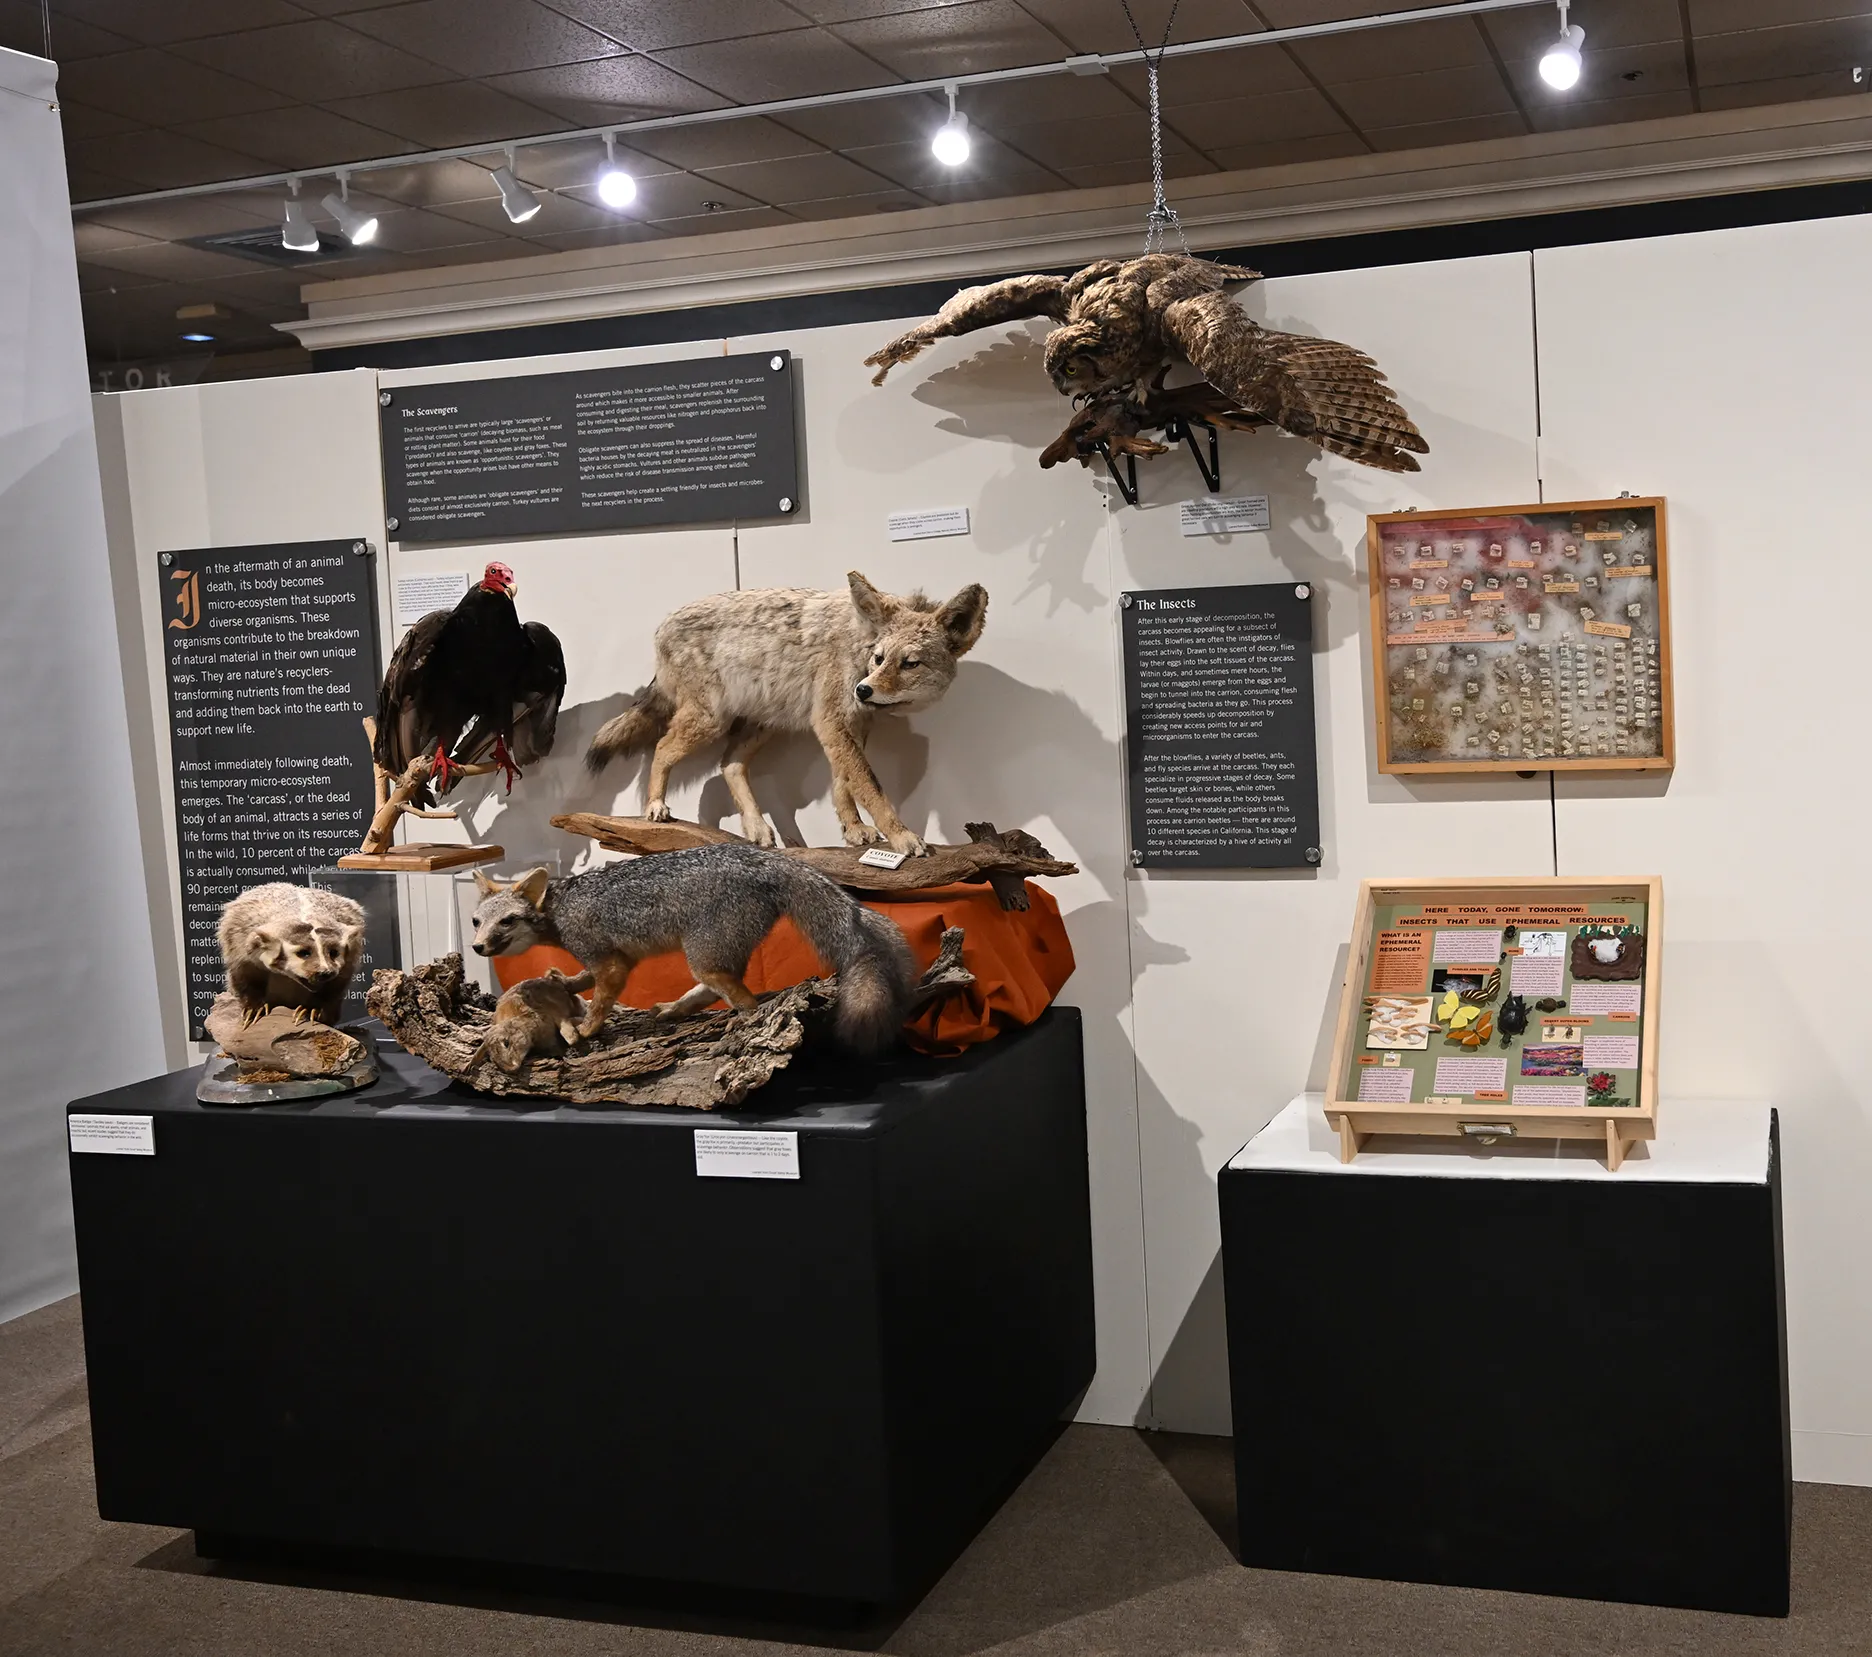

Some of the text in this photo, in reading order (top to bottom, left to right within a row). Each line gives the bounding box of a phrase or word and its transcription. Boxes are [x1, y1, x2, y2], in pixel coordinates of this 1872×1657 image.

[595, 399, 610, 407] which
[648, 393, 675, 402] accessible
[683, 391, 701, 399] smaller
[703, 389, 724, 397] animals.
[402, 406, 458, 417] The Scavengers
[206, 565, 211, 574] n
[214, 562, 230, 574] the
[233, 559, 279, 573] aftermath
[282, 557, 292, 570] of
[295, 559, 307, 569] an
[311, 554, 344, 568] animal
[206, 576, 324, 592] death, its body becomes
[208, 591, 356, 610] micro-ecosystem that supports
[1137, 598, 1195, 610] The Insects
[209, 611, 329, 628] diverse organisms. These
[1137, 617, 1153, 625] After
[1154, 616, 1167, 624] this
[1168, 615, 1184, 625] early
[1185, 615, 1203, 624] stage
[1204, 614, 1211, 622] of
[1212, 613, 1262, 622] decomposition,
[1138, 628, 1162, 636] carcass
[1163, 627, 1192, 635] becomes
[1193, 624, 1225, 634] appealing
[1243, 623, 1268, 631] subsect
[1270, 622, 1276, 630] of
[174, 627, 359, 650] organisms contribute to the breakdown
[171, 646, 356, 665] of natural material in their own unique
[173, 665, 333, 685] ways. They are nature's recyclers-
[174, 682, 350, 701] transforming nutrients from the dead
[176, 700, 363, 719] and adding them back into the earth to
[176, 722, 255, 738] support new life.
[179, 755, 352, 771] Almost immediately following death,
[180, 774, 331, 790] this temporary micro-ecosystem
[181, 790, 350, 808] emerges. The ‘carcass’, or the dead
[182, 808, 362, 826] body of an animal, attracts a series of
[184, 828, 362, 842] life forms that thrive on its resources.
[185, 845, 362, 860] In the wild, 10 percent of the carcas
[1162, 848, 1173, 856] the
[186, 865, 194, 877] is
[197, 865, 233, 879] actually
[236, 864, 288, 876] consumed,
[187, 883, 200, 895] 90
[203, 883, 238, 897] percent
[192, 972, 202, 983] to
